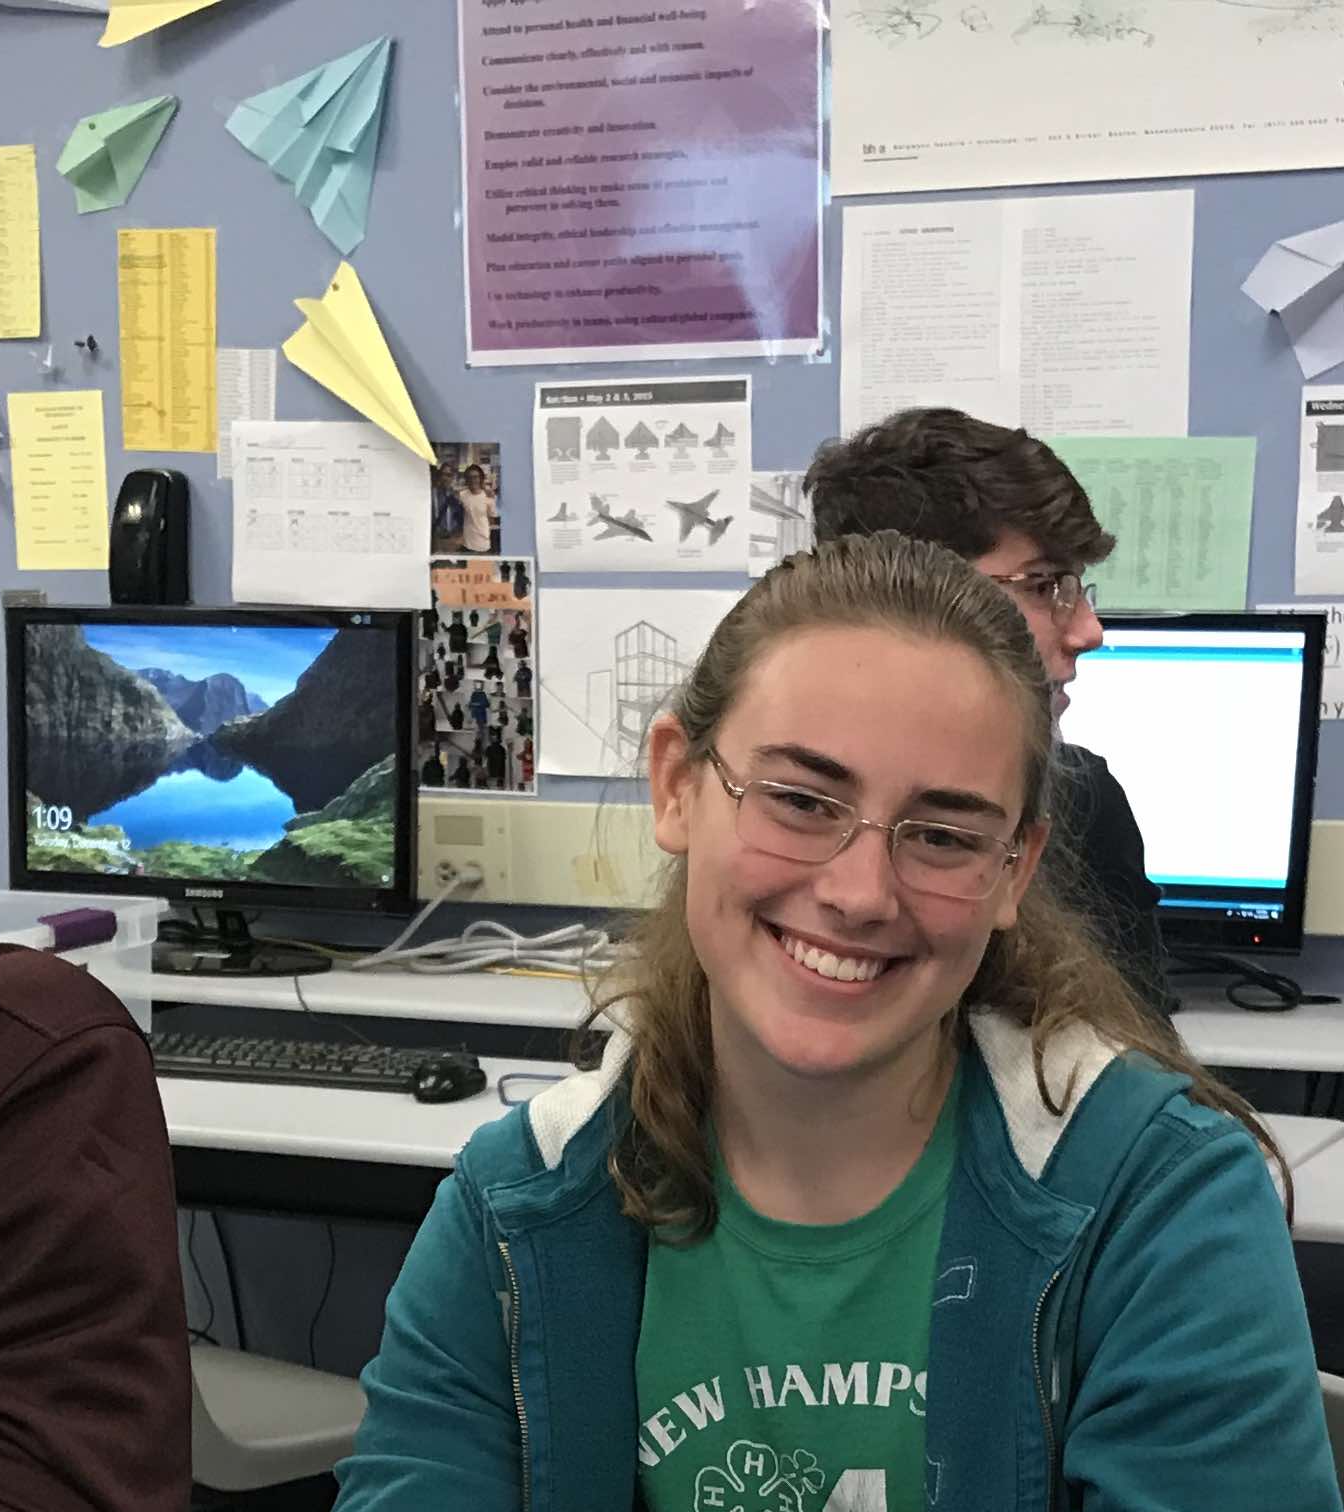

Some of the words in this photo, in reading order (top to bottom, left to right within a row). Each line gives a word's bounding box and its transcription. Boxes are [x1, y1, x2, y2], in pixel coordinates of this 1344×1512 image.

[32, 806, 72, 830] 1:09
[71, 836, 118, 850] December
[121, 838, 132, 850] 12
